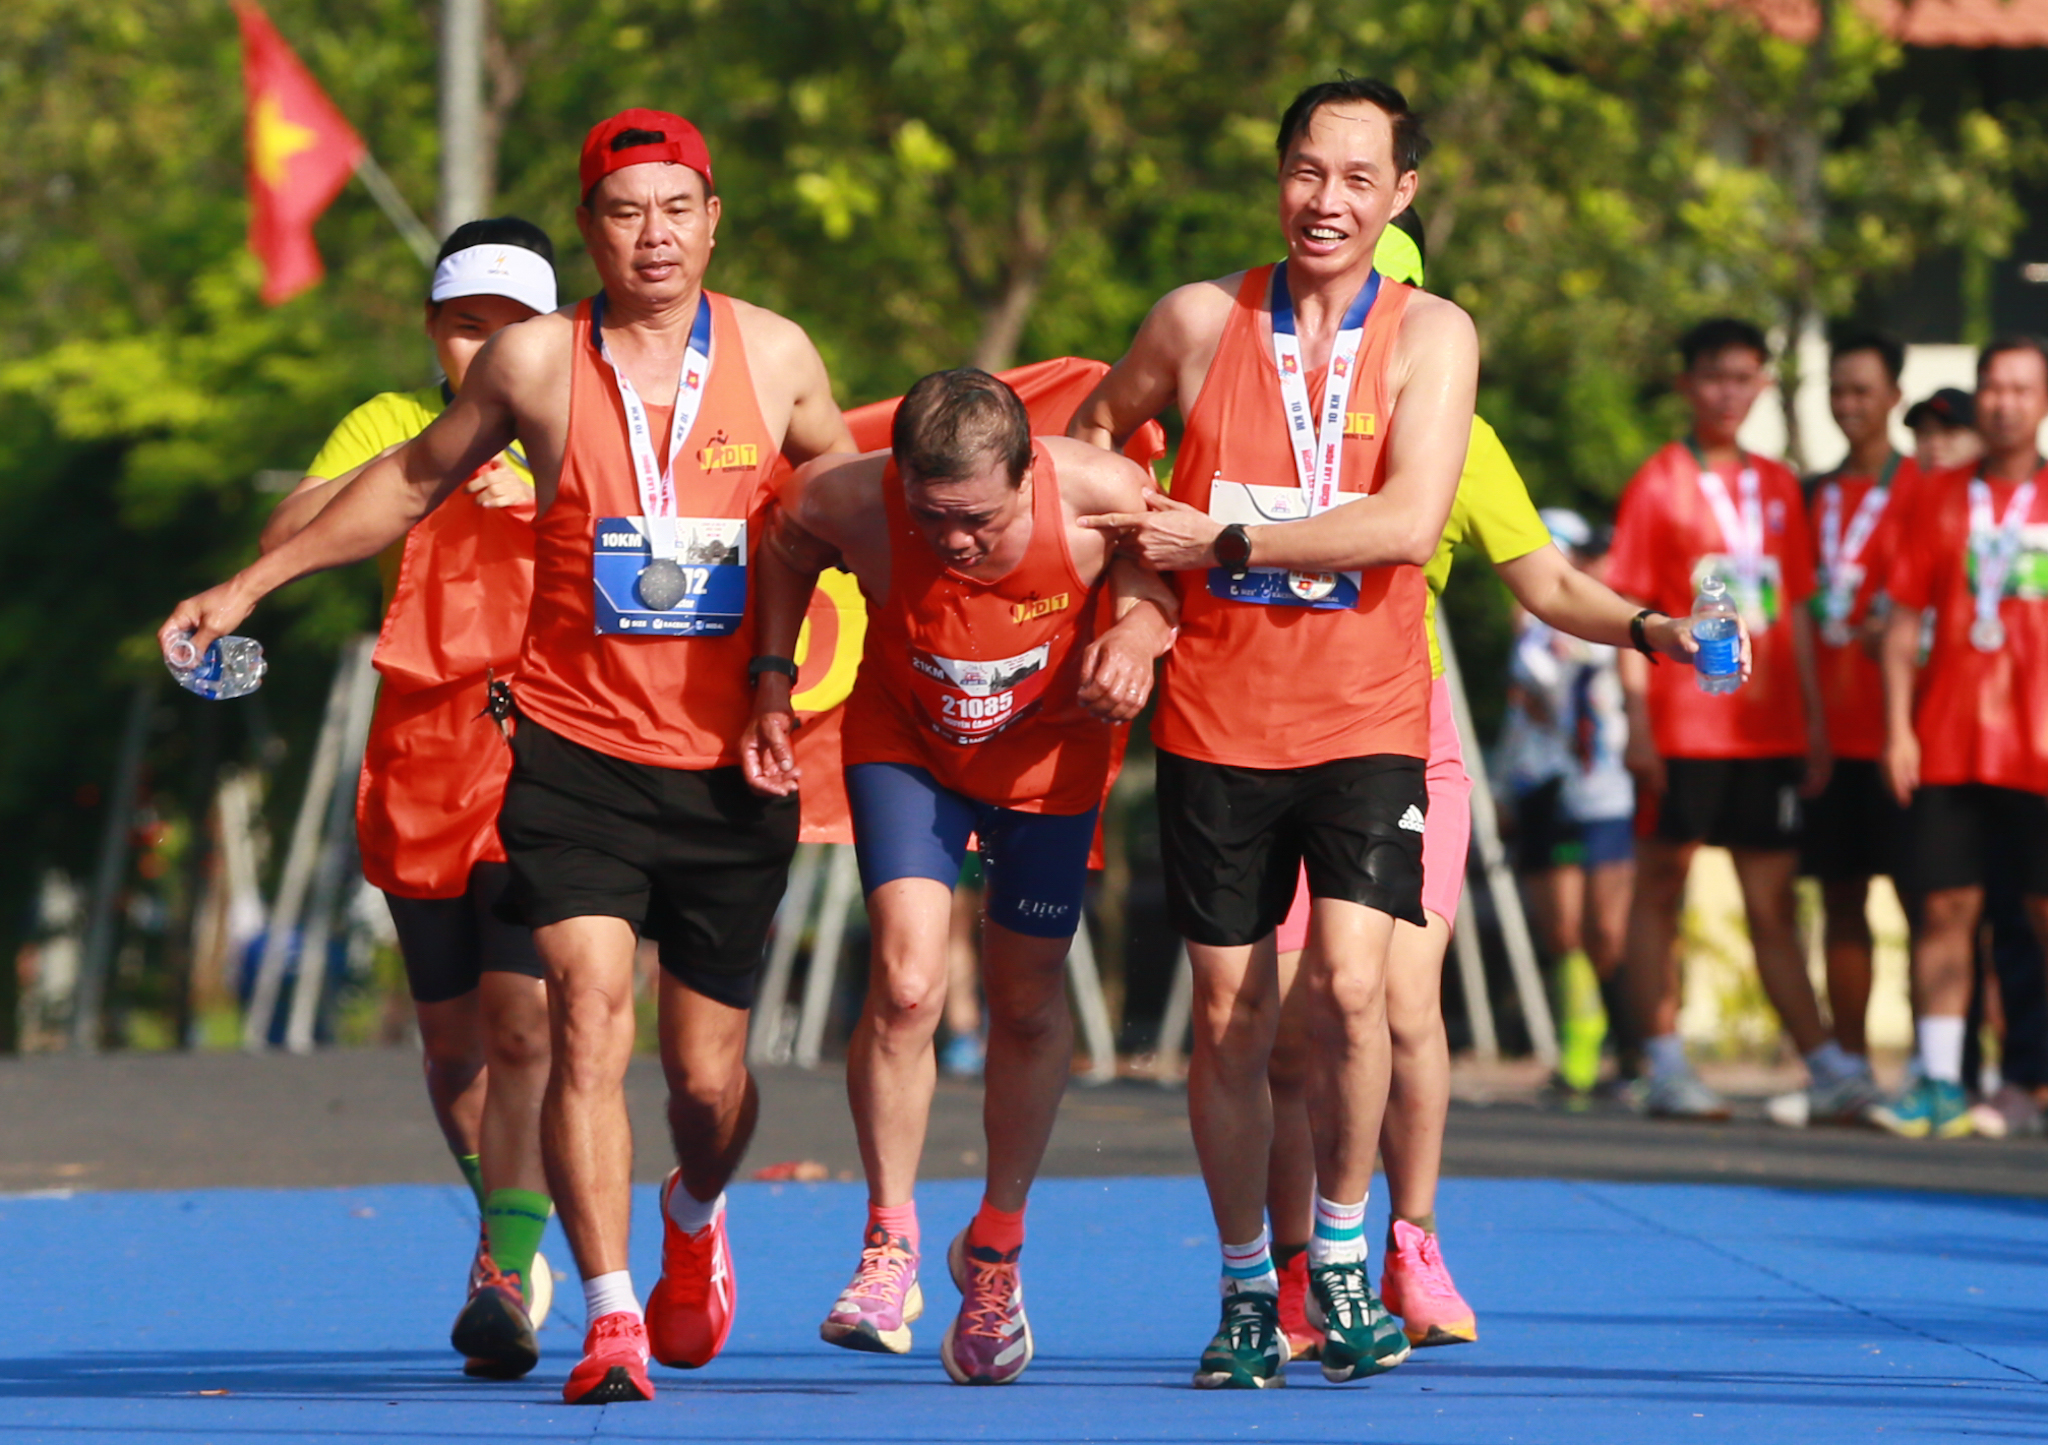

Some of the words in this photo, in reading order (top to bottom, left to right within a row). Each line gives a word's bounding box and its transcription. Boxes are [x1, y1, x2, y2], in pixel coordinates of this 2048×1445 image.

[1291, 401, 1302, 412] 10
[1330, 394, 1340, 409] KM
[1294, 415, 1306, 431] KM
[1328, 412, 1338, 423] 10
[601, 532, 643, 548] 10KM
[912, 656, 946, 680] 21KM
[941, 690, 1014, 719] 21085
[1018, 899, 1068, 914] Elite
